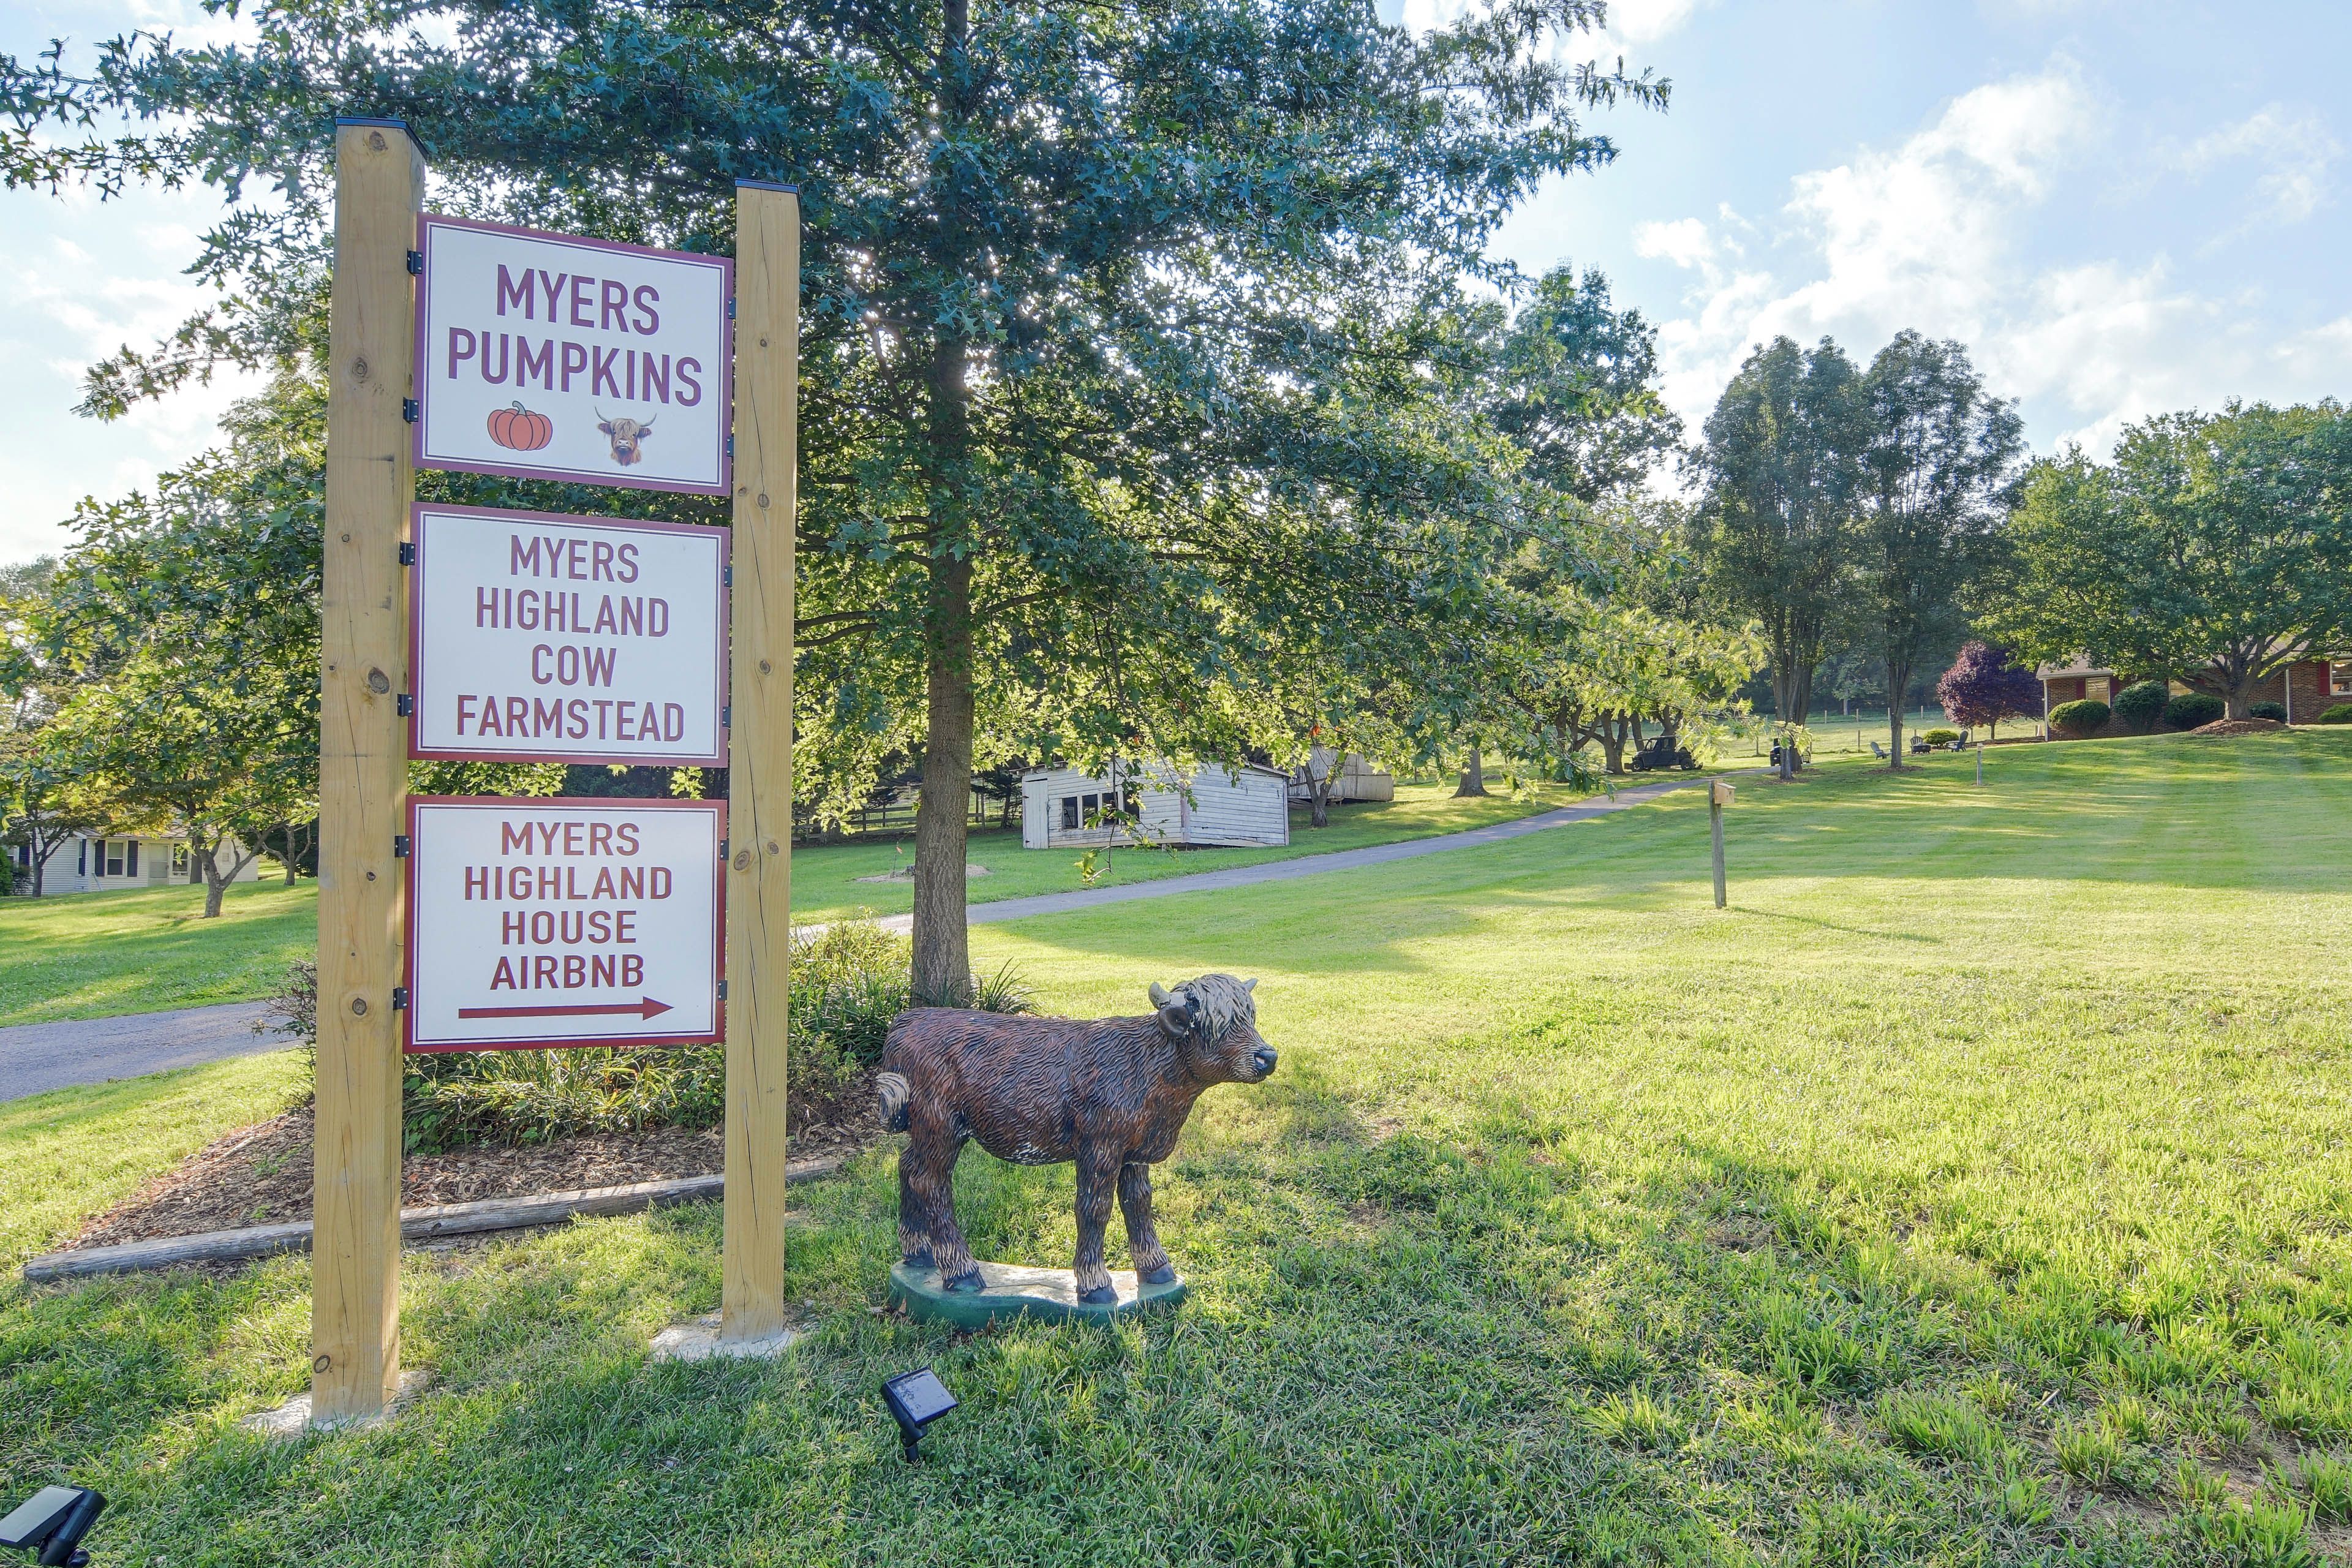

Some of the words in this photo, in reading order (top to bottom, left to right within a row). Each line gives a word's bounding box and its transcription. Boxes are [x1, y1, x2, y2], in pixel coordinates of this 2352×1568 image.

[497, 263, 660, 335] MYERS
[448, 326, 702, 407] PUMPKINS
[511, 534, 639, 584] MYERS
[477, 586, 669, 638] HIGHLAND
[532, 644, 617, 687] COW
[457, 694, 684, 742] FARMSTEAD
[502, 821, 639, 856] MYERS
[465, 866, 672, 900] HIGHLAND
[502, 910, 637, 945] HOUSE
[489, 954, 644, 990] AIRBNB
